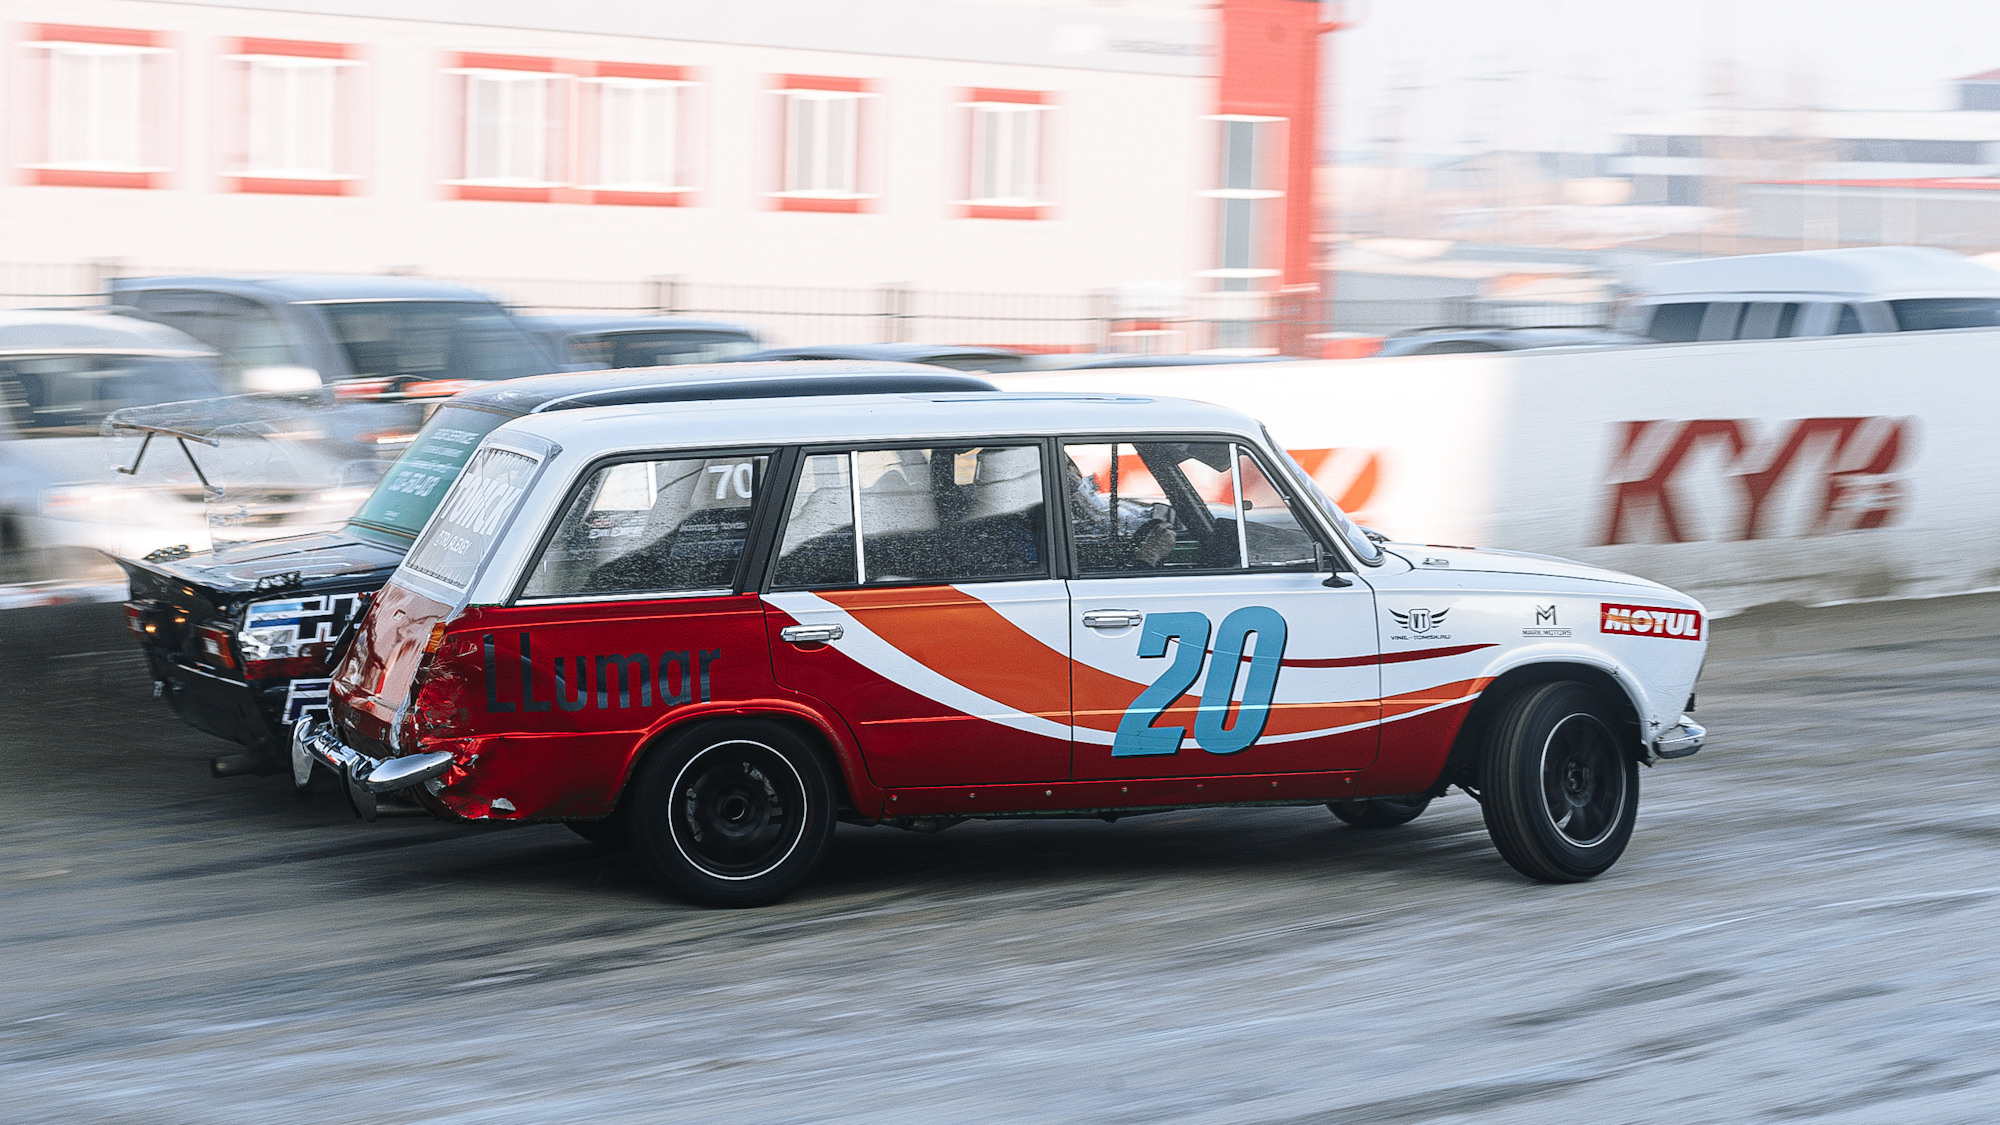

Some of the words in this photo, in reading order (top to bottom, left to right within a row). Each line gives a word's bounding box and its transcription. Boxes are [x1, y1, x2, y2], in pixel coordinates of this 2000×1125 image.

[707, 462, 753, 500] 70
[1586, 417, 1914, 546] KYB
[1603, 607, 1699, 637] MOTUL
[483, 632, 722, 713] LLumar
[1111, 605, 1289, 759] 20
